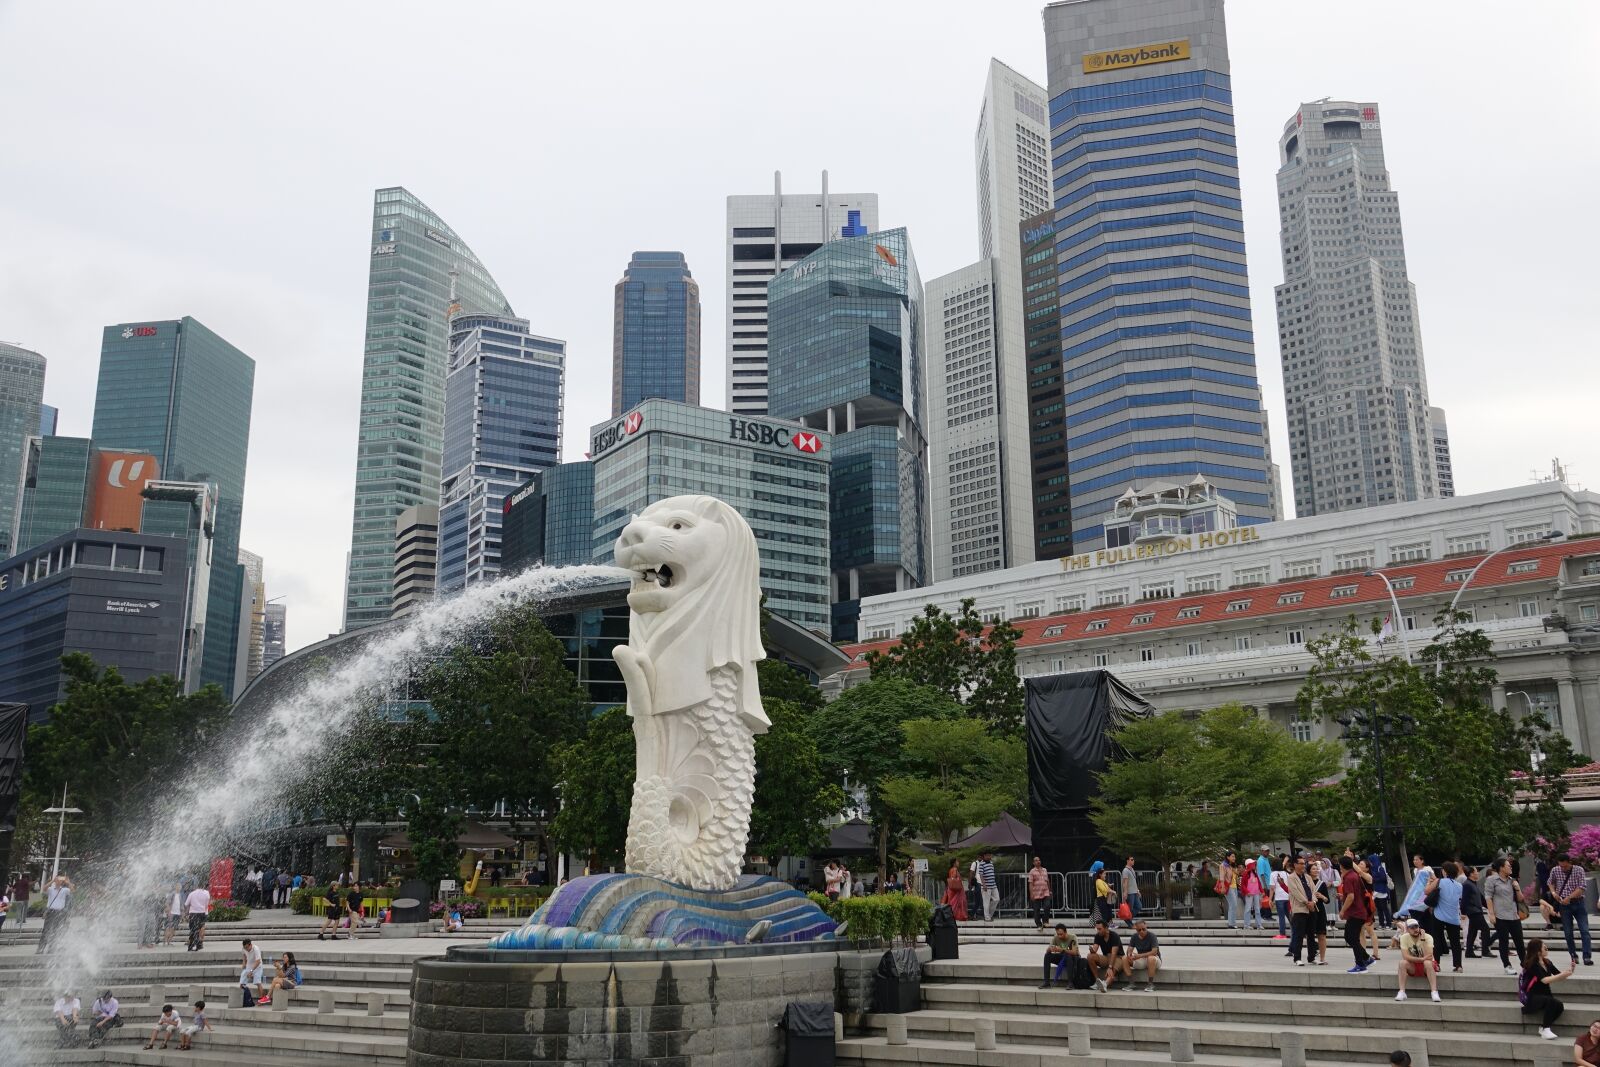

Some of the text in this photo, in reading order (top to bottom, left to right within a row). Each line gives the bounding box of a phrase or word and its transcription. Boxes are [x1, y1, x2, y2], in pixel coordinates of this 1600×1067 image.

[1105, 45, 1180, 65] Maybank
[1361, 122, 1380, 130] UOB
[427, 229, 451, 246] Keppel
[372, 243, 397, 255] ANZ
[794, 261, 817, 279] MYP
[134, 327, 157, 336] UBS
[593, 420, 625, 456] HSBC
[729, 418, 790, 448] HSBC
[1060, 527, 1260, 571] THE FULLERTON HOTEL
